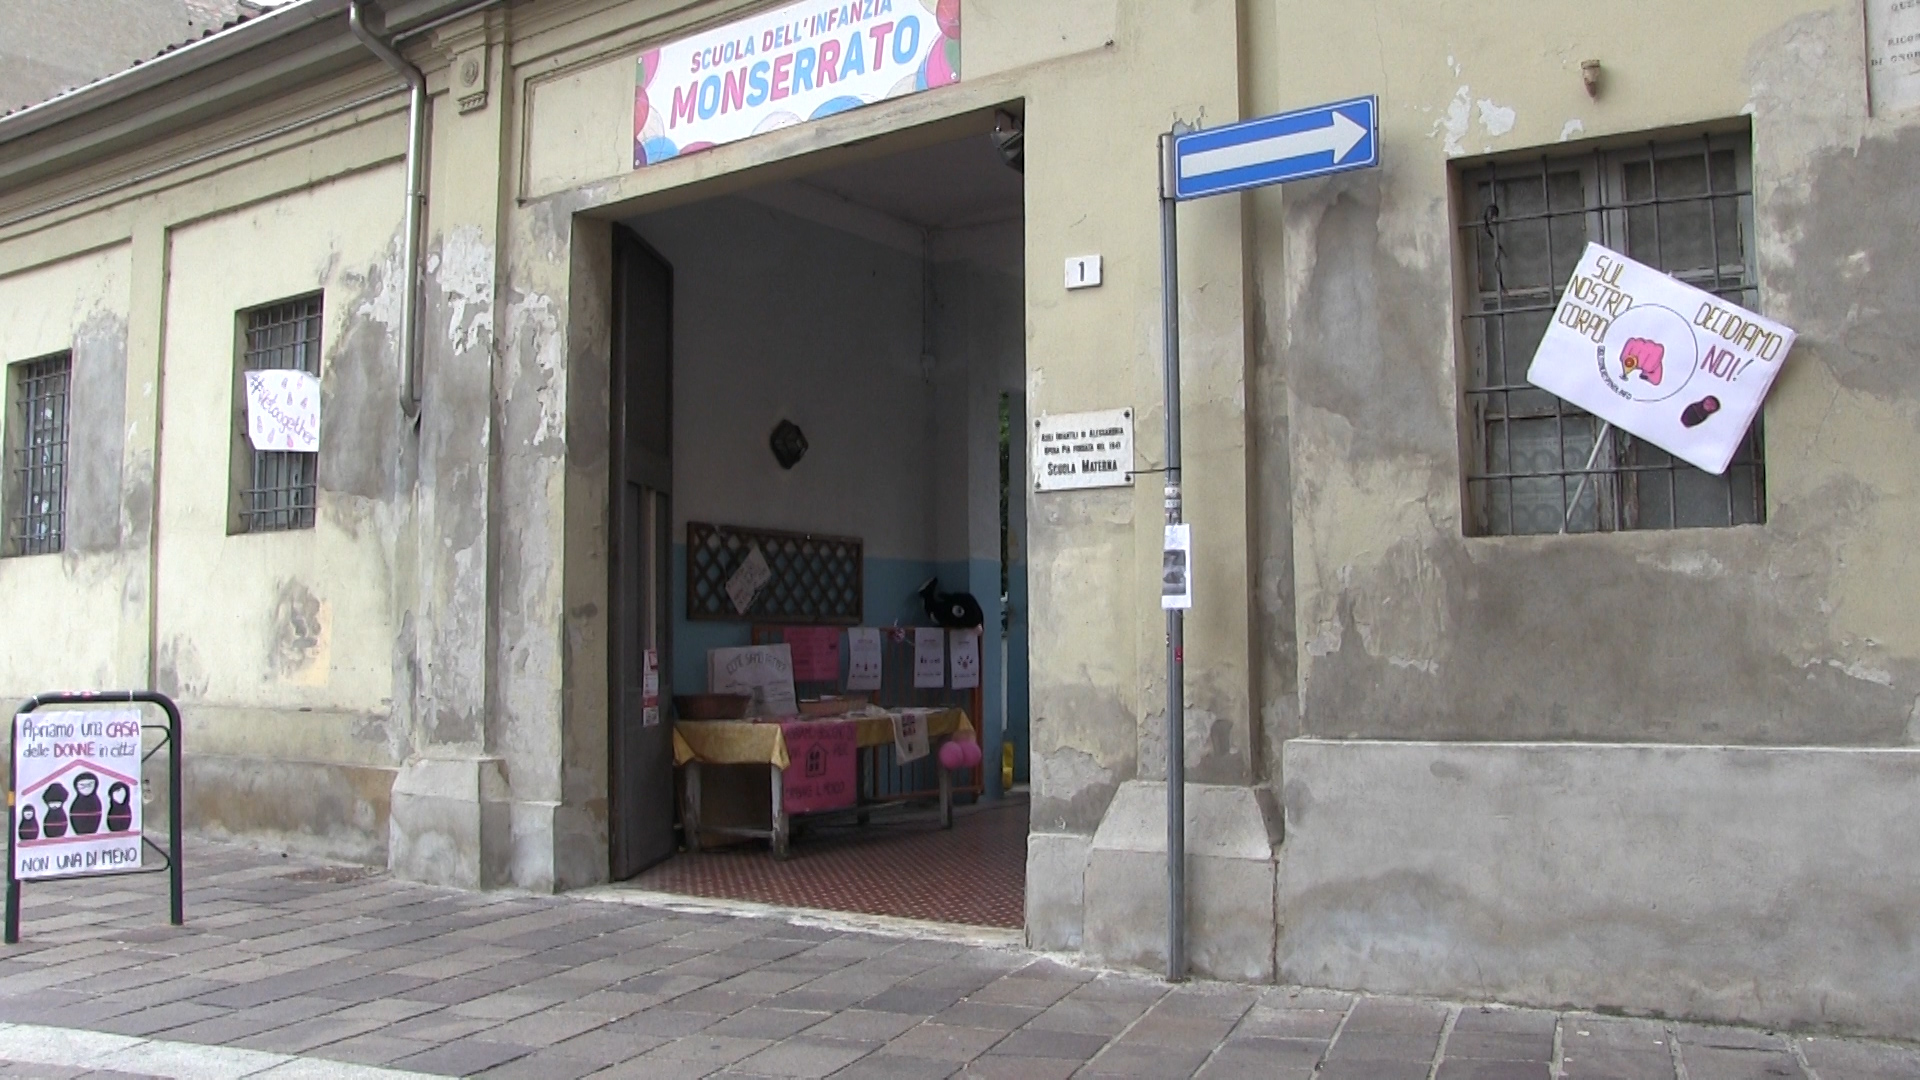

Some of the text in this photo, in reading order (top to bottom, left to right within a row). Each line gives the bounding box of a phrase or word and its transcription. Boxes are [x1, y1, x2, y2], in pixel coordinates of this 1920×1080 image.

[690, 0, 893, 74] SCUOLA DELL'INFANZIA
[669, 15, 920, 129] MONSERRATO
[1078, 261, 1085, 282] 1
[1592, 254, 1624, 289] SUL
[1568, 274, 1633, 319] NOSTRO
[1558, 301, 1609, 344] CORPO
[1693, 301, 1783, 362] DECIDIAMO
[1700, 344, 1754, 382] NOI!
[1081, 459, 1118, 473] MATERNA
[22, 718, 74, 741] Apriamo
[105, 721, 139, 738] CASA
[23, 743, 50, 758] delle
[53, 741, 96, 758] DONNE
[99, 744, 108, 757] in
[21, 847, 138, 872] NON UNA DI MENO
